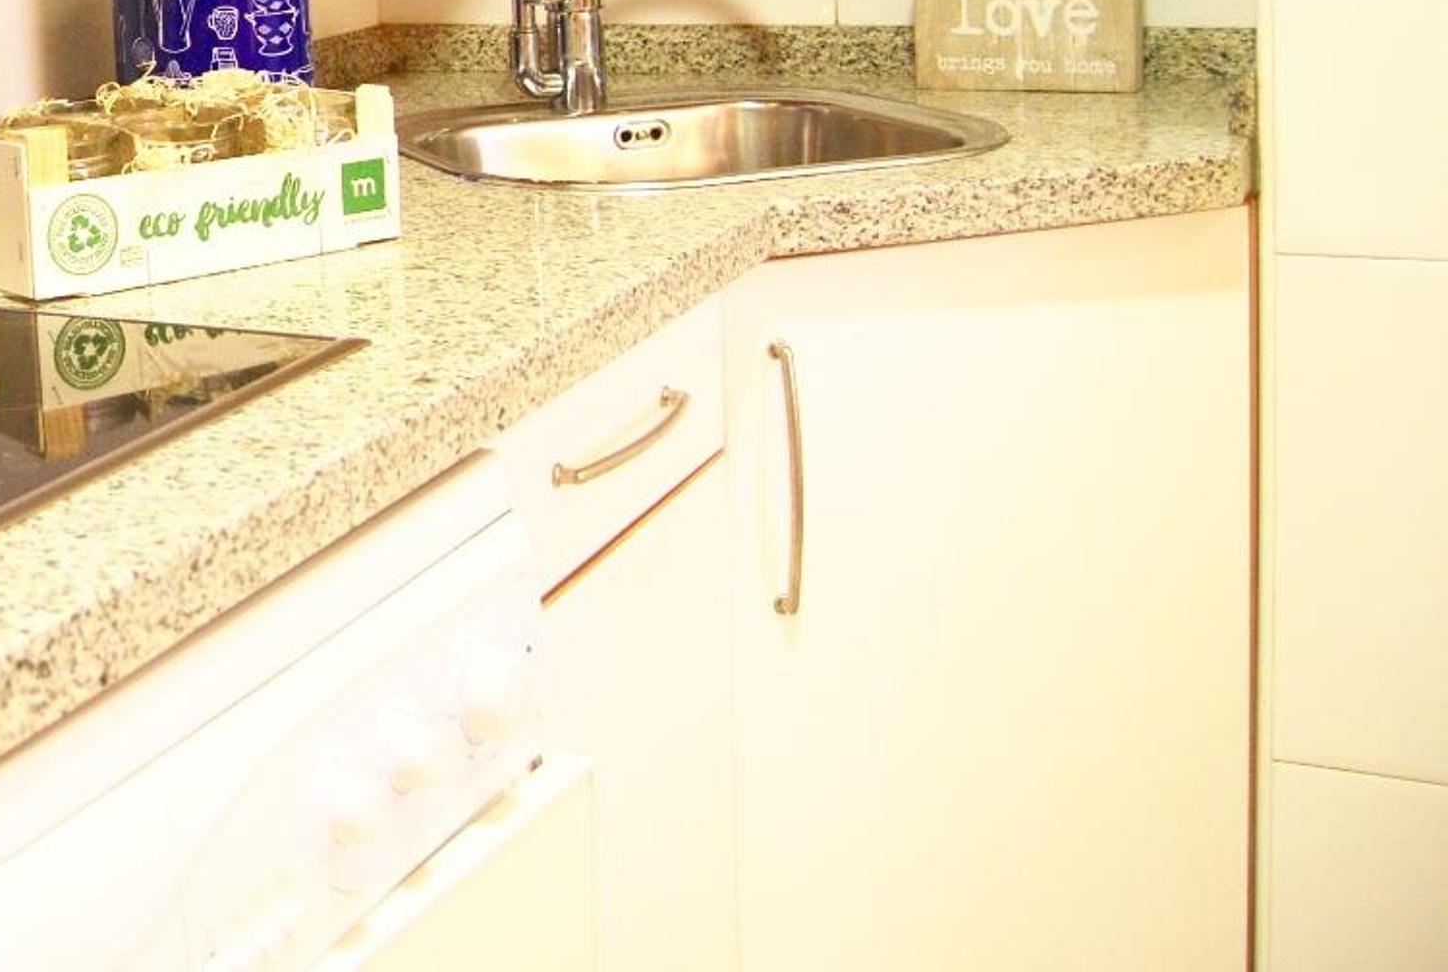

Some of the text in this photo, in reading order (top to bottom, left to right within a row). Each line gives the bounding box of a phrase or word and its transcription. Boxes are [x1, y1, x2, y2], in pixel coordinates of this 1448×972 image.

[936, 53, 1118, 81] brings you home
[350, 177, 377, 198] m
[139, 212, 186, 240] eco
[195, 172, 326, 242] friendly
